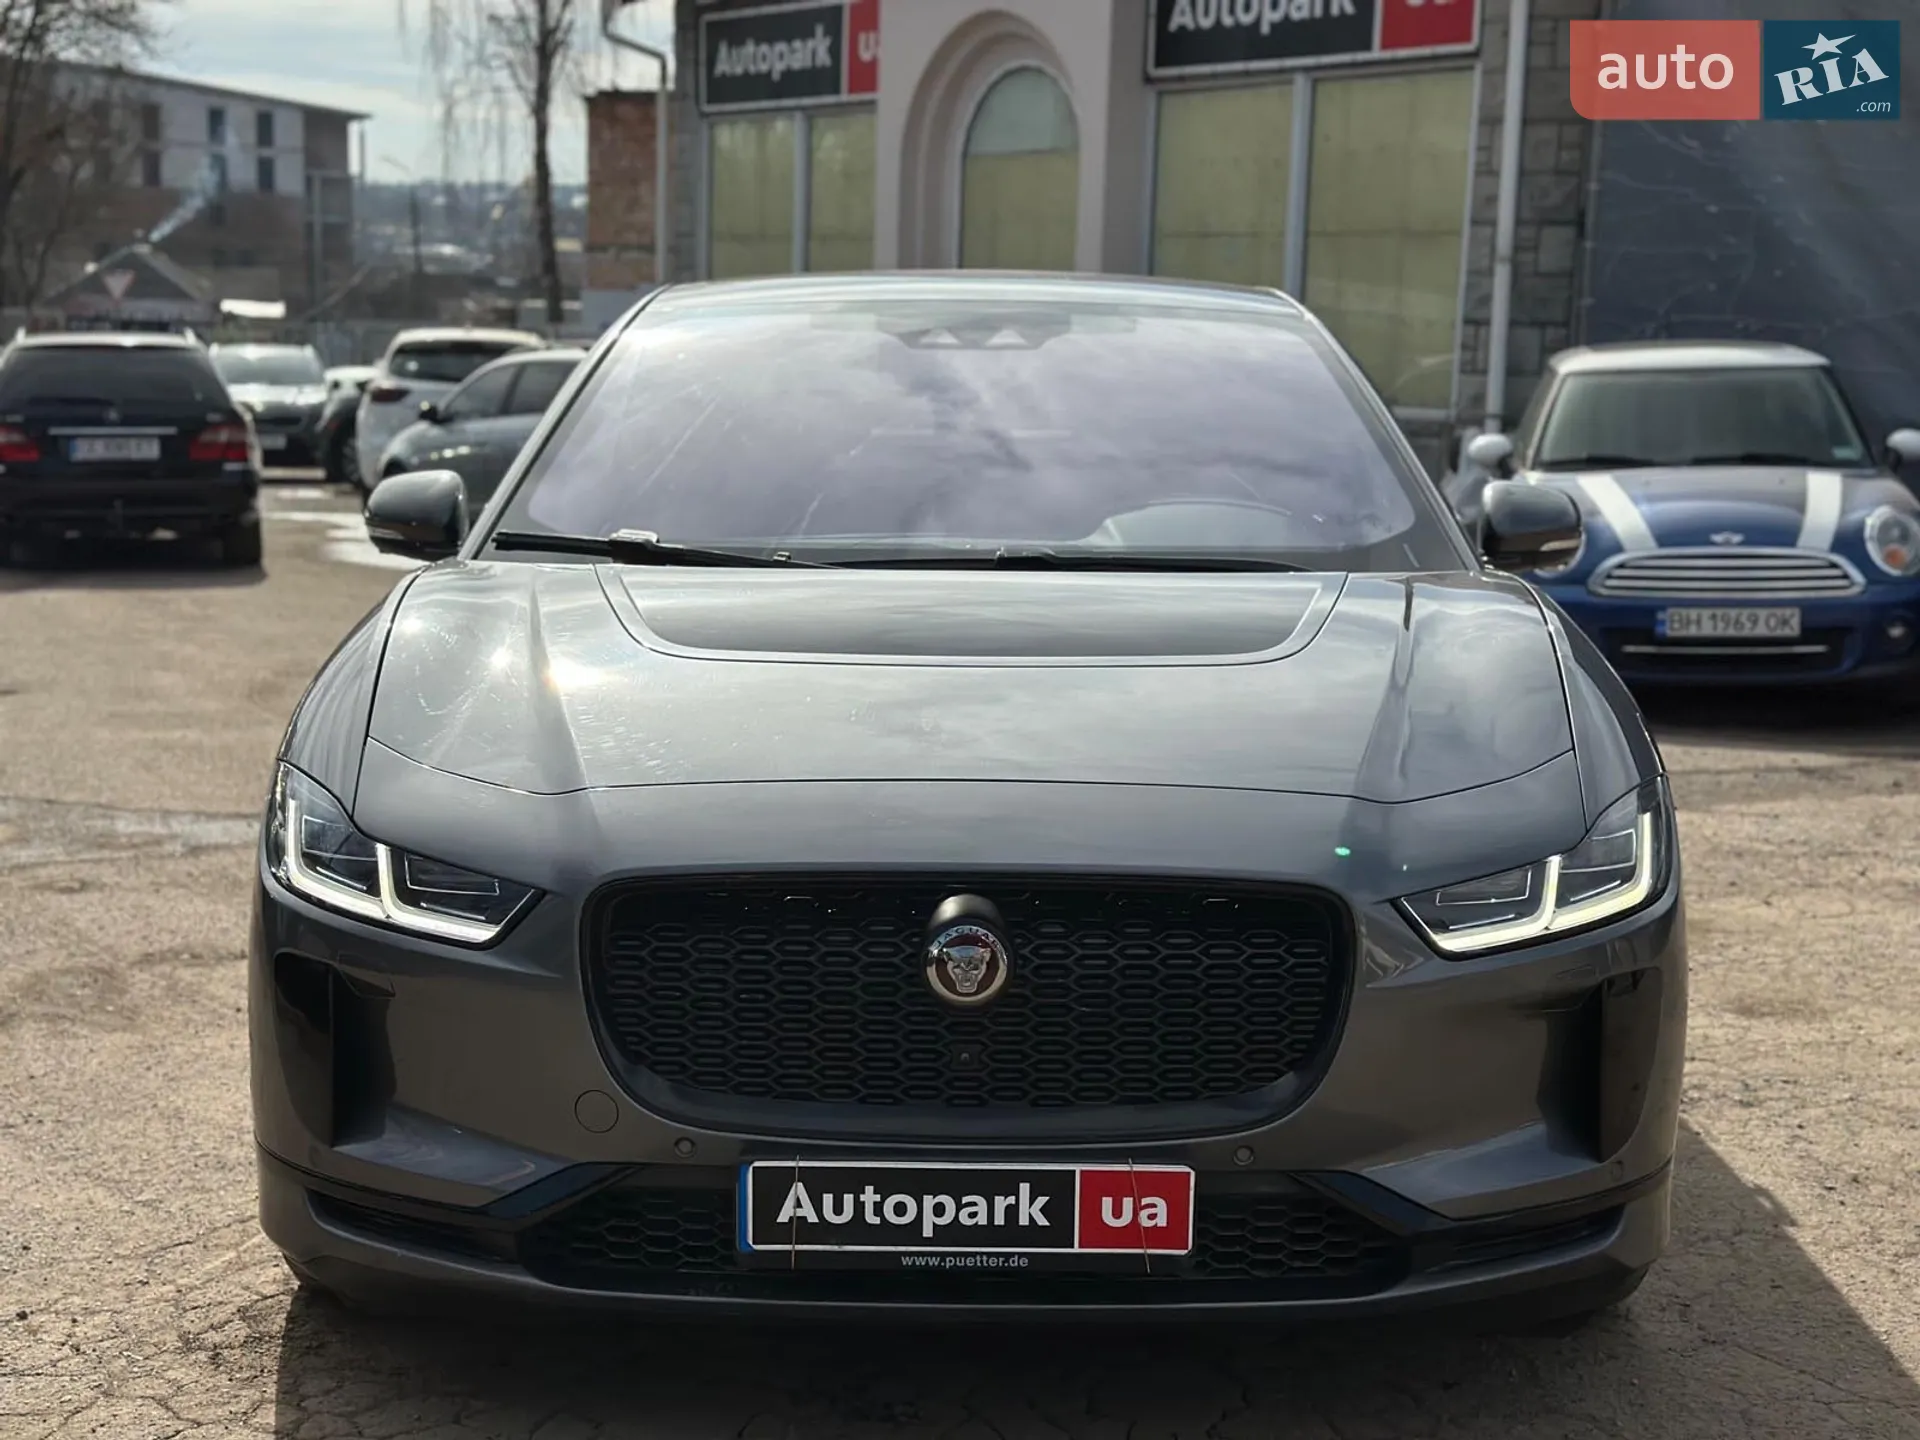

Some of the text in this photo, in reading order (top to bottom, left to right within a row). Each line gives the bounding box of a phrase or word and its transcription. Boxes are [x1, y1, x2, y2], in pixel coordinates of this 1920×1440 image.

[714, 23, 879, 82] Autopark u
[1669, 611, 1796, 633] BH 1969 OK
[936, 926, 1001, 948] JAGUAR
[776, 1182, 1168, 1238] Autopark ua
[901, 1253, 1029, 1269] www.puetter.de
